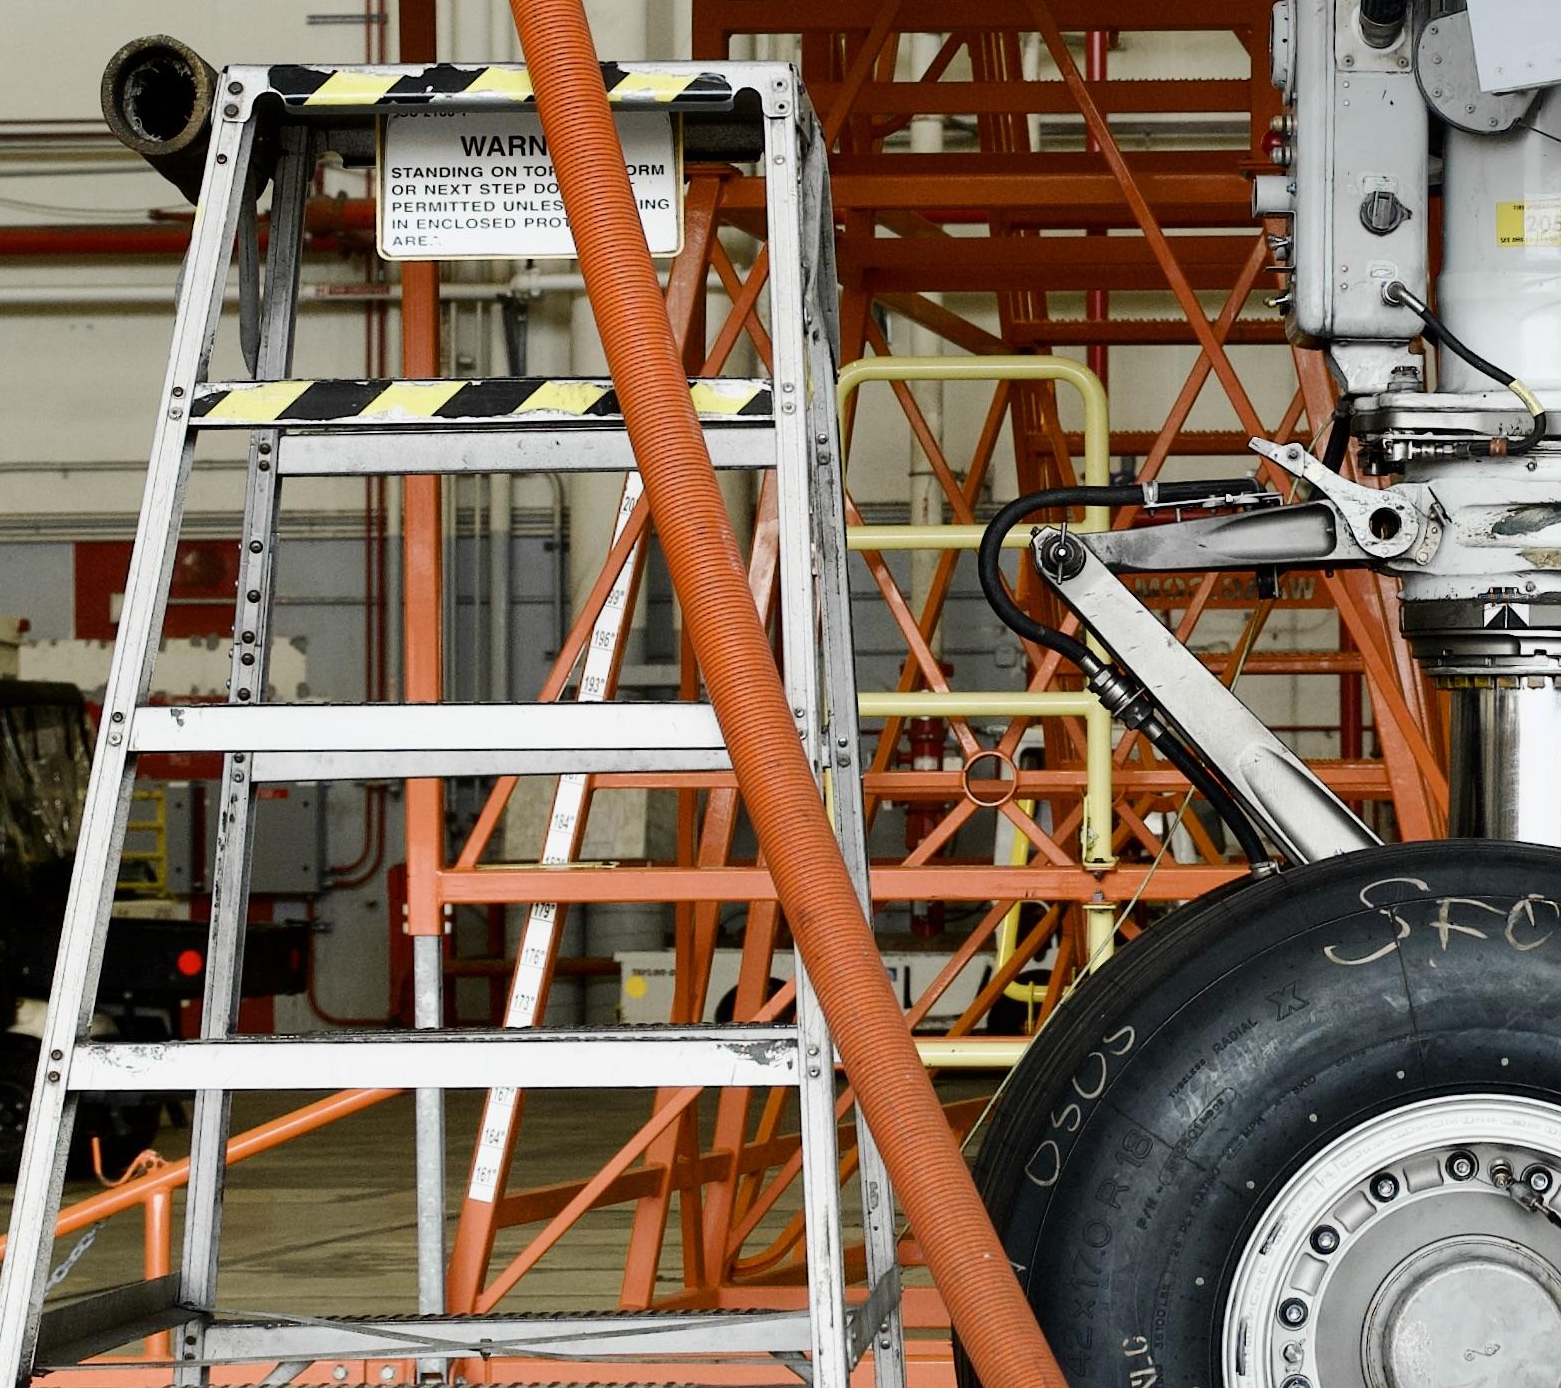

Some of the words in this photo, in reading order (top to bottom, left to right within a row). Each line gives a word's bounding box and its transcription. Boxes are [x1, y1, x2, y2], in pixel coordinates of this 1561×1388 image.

[460, 135, 548, 157] WARN
[391, 165, 484, 180] STANDING
[490, 165, 518, 179] ON
[391, 183, 418, 197] OR
[424, 183, 473, 197] NEXT
[479, 183, 527, 196] STEP
[534, 183, 561, 196] DO
[392, 200, 496, 214] PERMITTED
[503, 200, 565, 213] UNLES
[392, 218, 410, 231] IN
[416, 217, 517, 231] ENCLOSED
[1212, 1017, 1258, 1057] RADIAL
